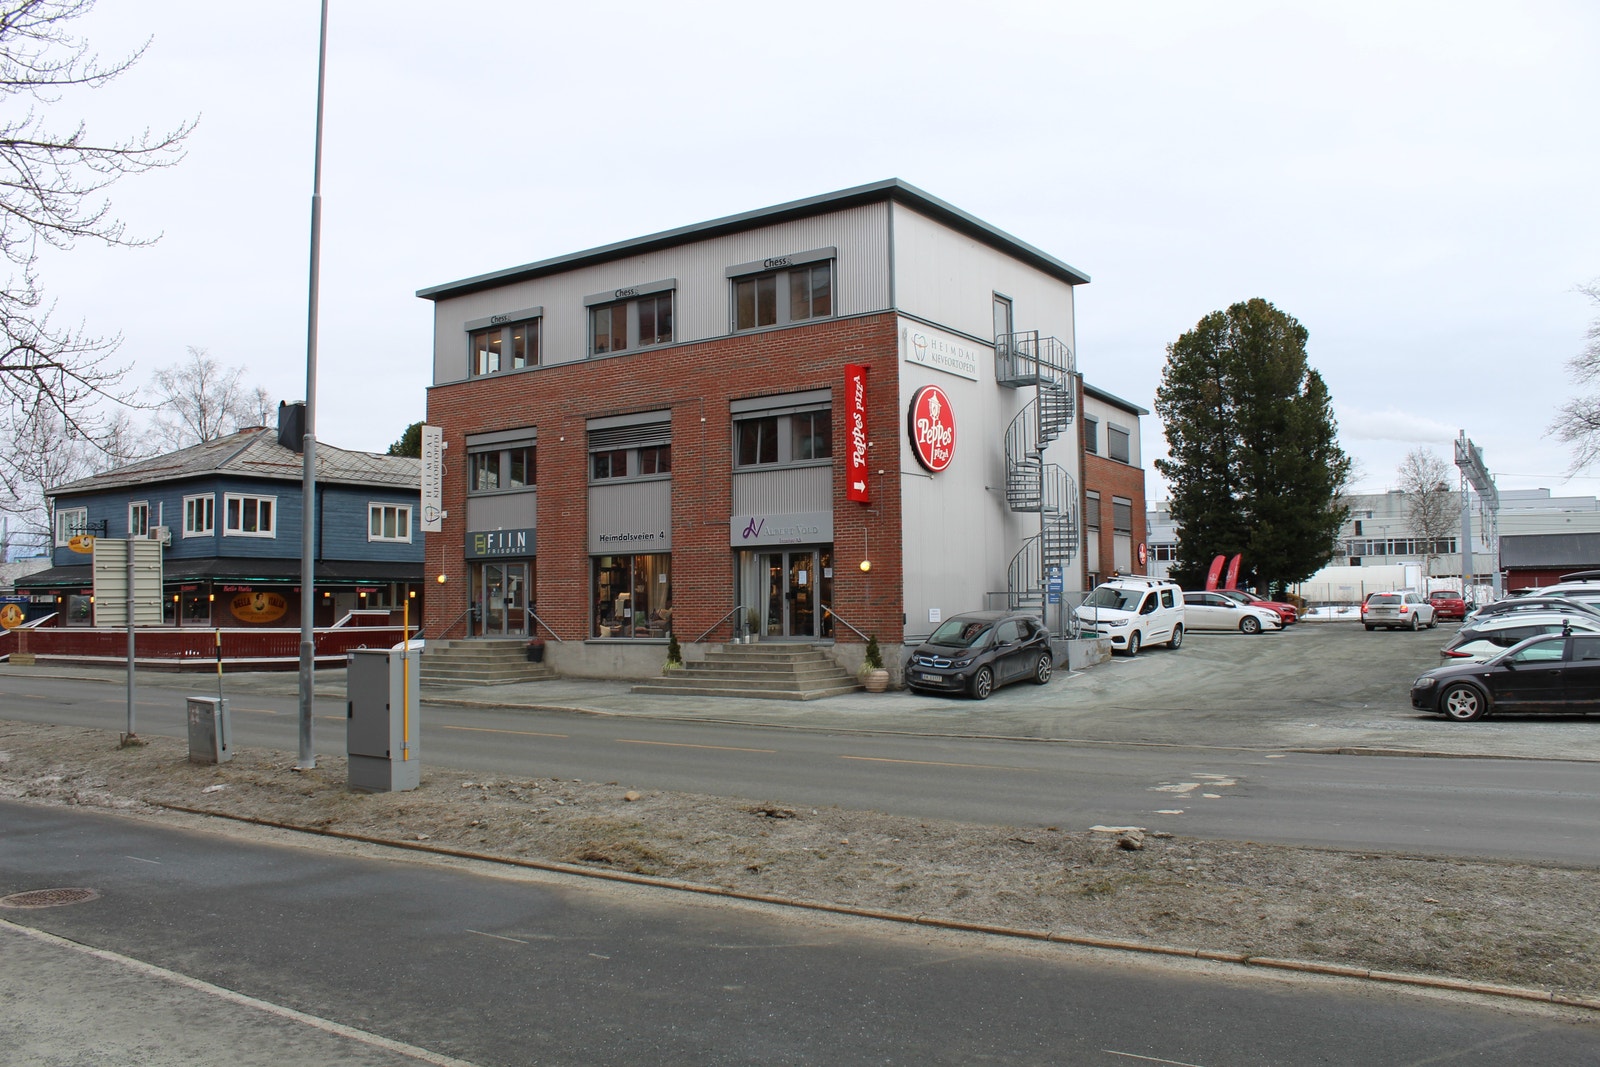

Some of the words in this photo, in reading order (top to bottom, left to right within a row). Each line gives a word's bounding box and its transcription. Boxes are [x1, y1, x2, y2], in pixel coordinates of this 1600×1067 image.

[763, 258, 787, 268] Chess
[931, 340, 975, 361] HEIMDAL
[852, 412, 867, 468] Peppes
[918, 418, 952, 447] Peppes
[487, 532, 526, 549] FIIN
[600, 533, 654, 541] Heimdalsveien
[660, 531, 665, 539] 4
